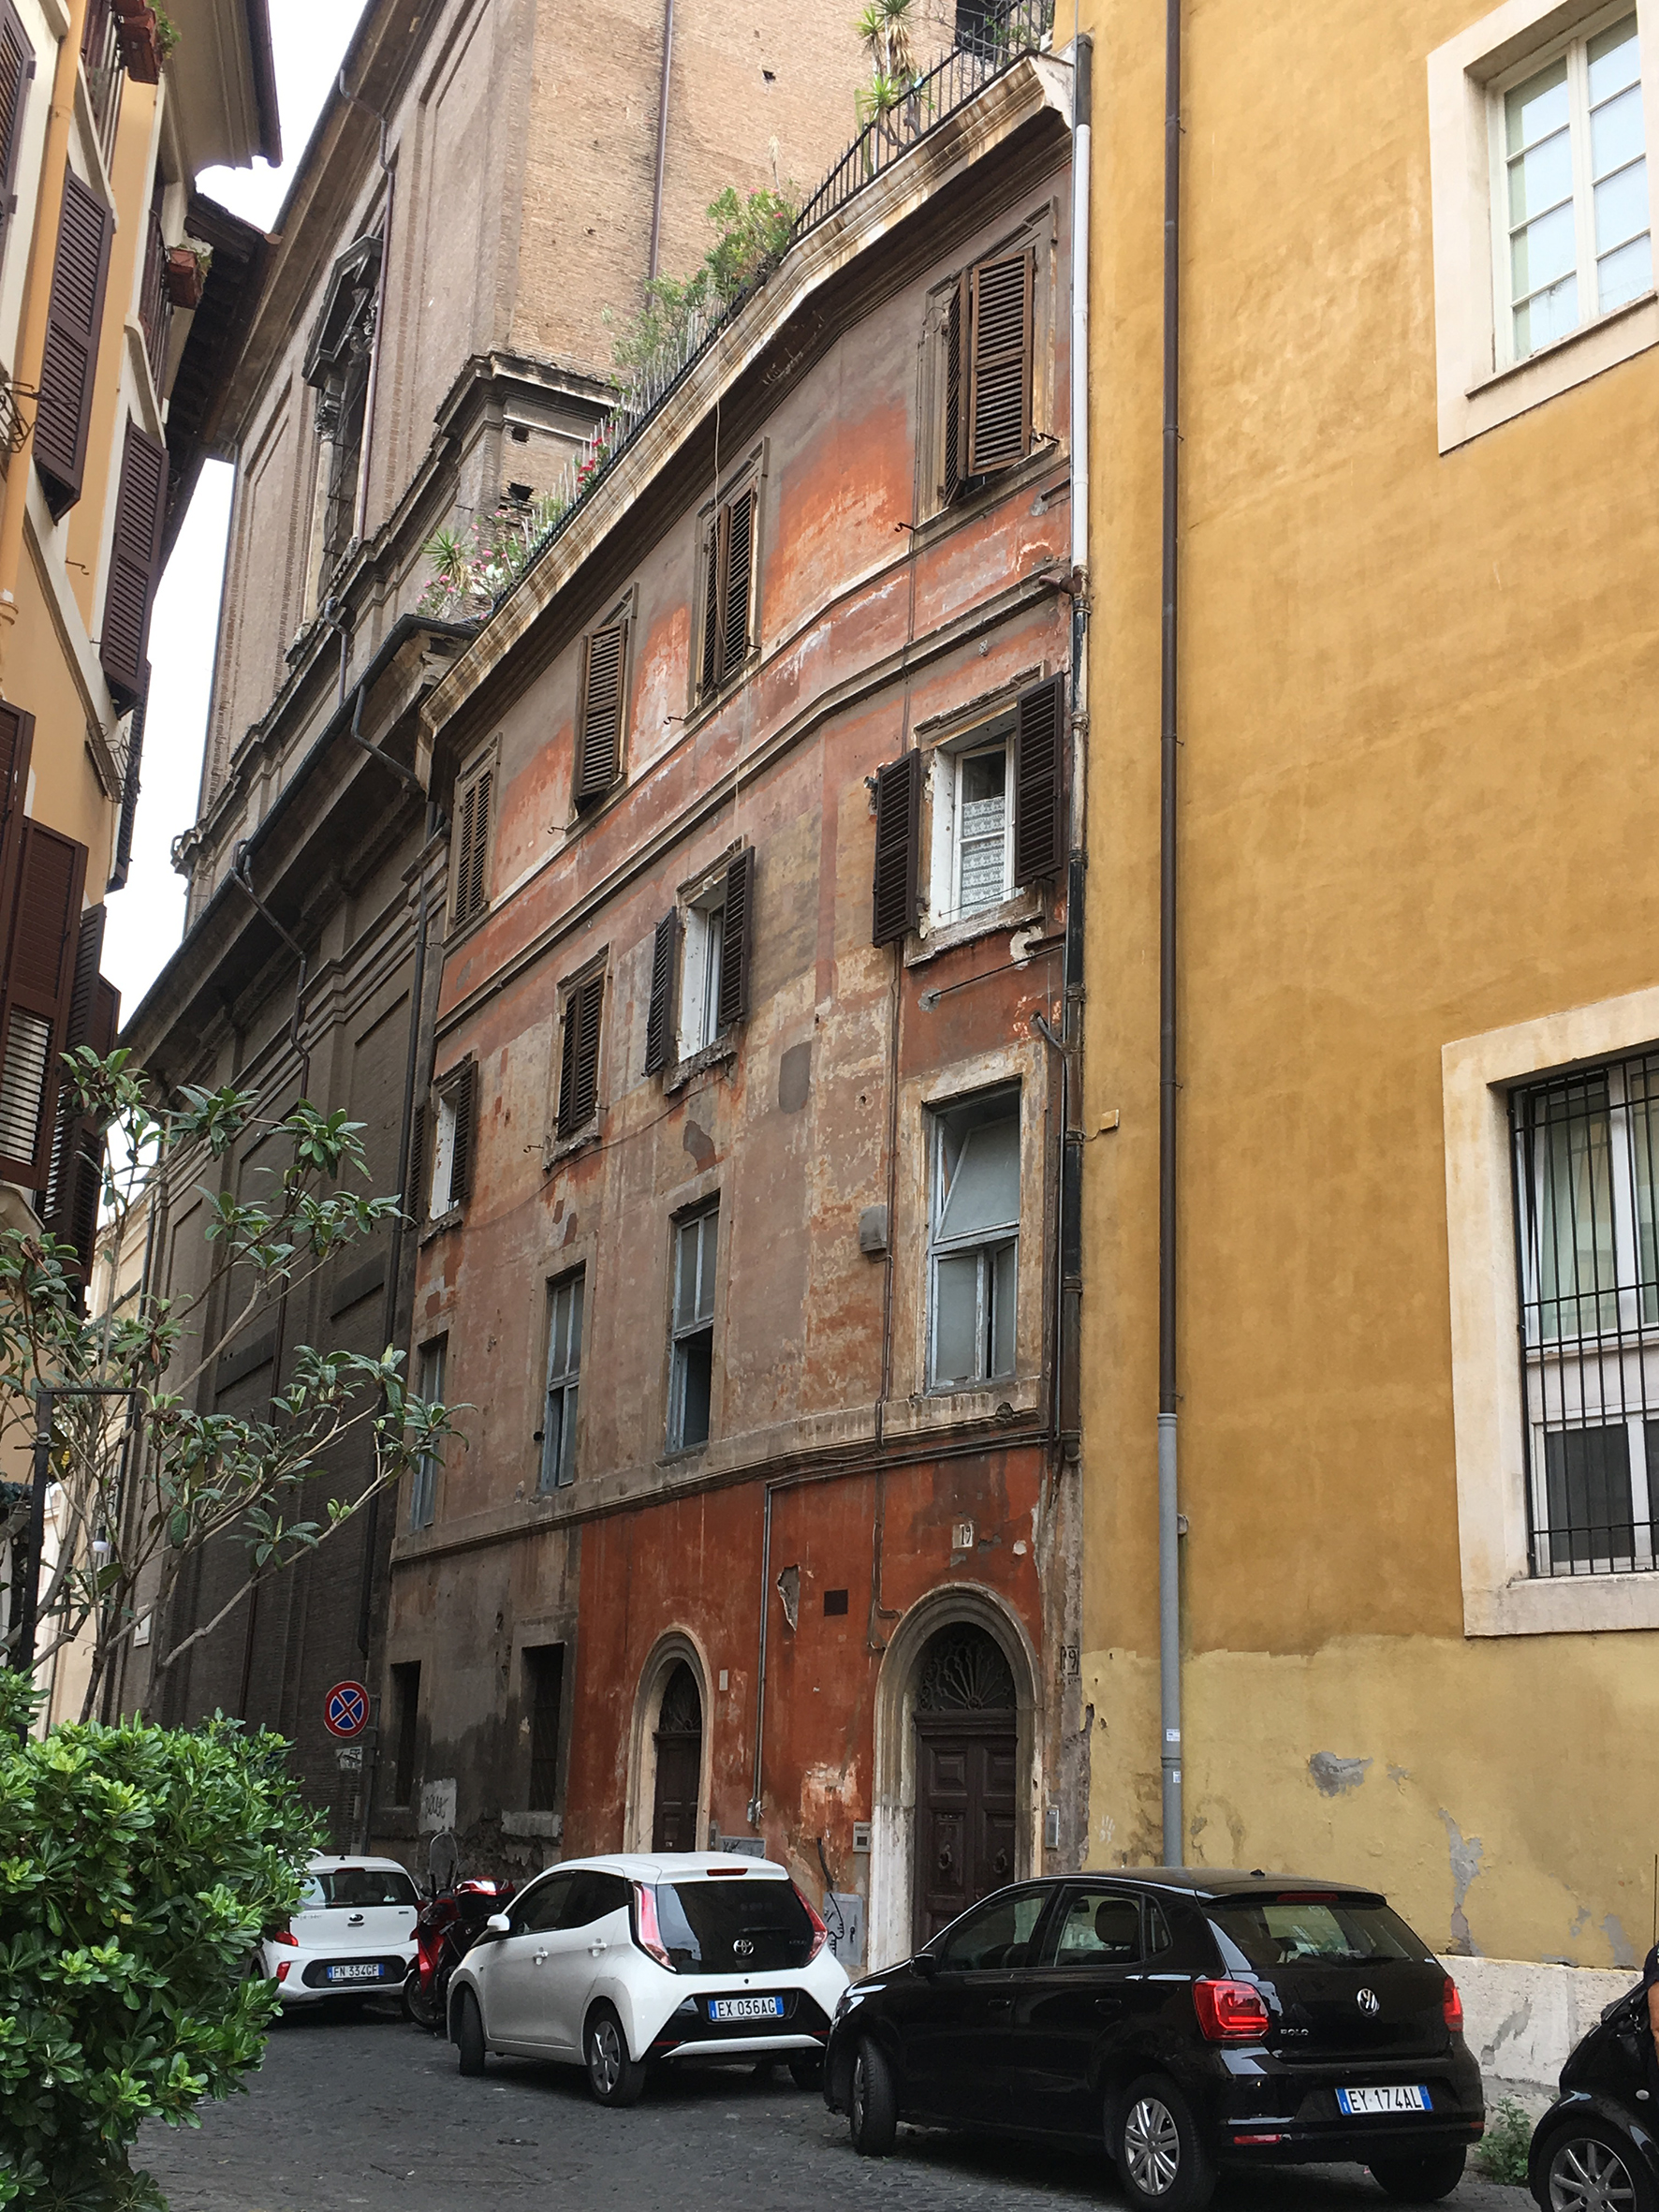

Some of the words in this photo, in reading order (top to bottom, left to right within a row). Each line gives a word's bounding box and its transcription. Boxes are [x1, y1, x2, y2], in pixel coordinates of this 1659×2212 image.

[961, 1526, 972, 1545] 19
[333, 1967, 345, 1977] FN
[717, 2000, 733, 2016] EX
[737, 1998, 775, 2015] 036AG
[1348, 2090, 1369, 2111] EY
[1374, 2087, 1422, 2109] 174AL
